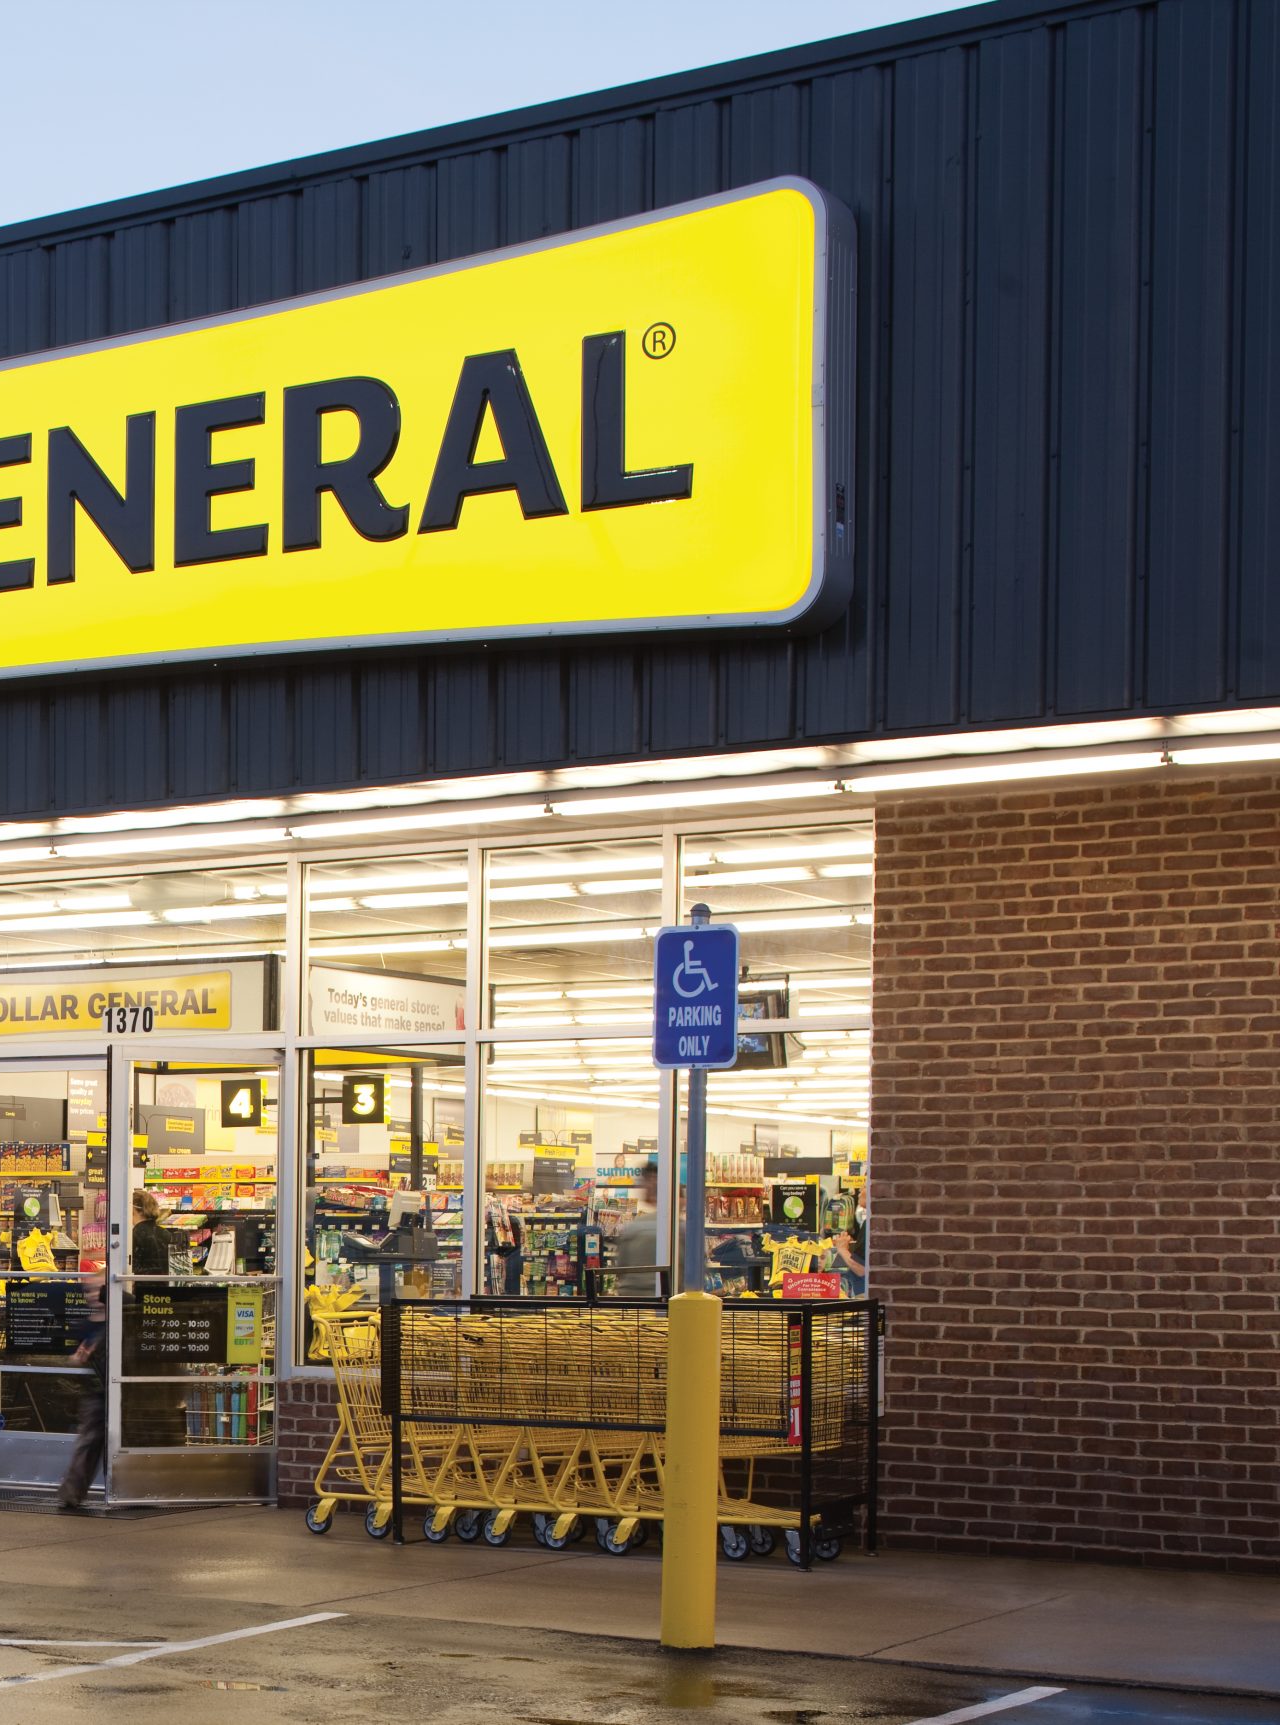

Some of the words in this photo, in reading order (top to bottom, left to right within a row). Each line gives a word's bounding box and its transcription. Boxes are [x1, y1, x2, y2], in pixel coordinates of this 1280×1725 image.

[327, 988, 368, 1009] Today's
[370, 996, 408, 1012] general
[411, 1000, 440, 1016] store:
[105, 1006, 153, 1034] 1370
[324, 1008, 358, 1026] values
[361, 1012, 382, 1029] that
[384, 1014, 412, 1031] make
[668, 1005, 722, 1027] PARKING
[678, 1035, 710, 1057] ONLY
[229, 1088, 253, 1118] 4
[353, 1084, 375, 1115] 3
[88, 1168, 103, 1176] great
[143, 1294, 171, 1304] Store
[143, 1306, 174, 1315] Hours
[237, 1310, 254, 1318] VISA
